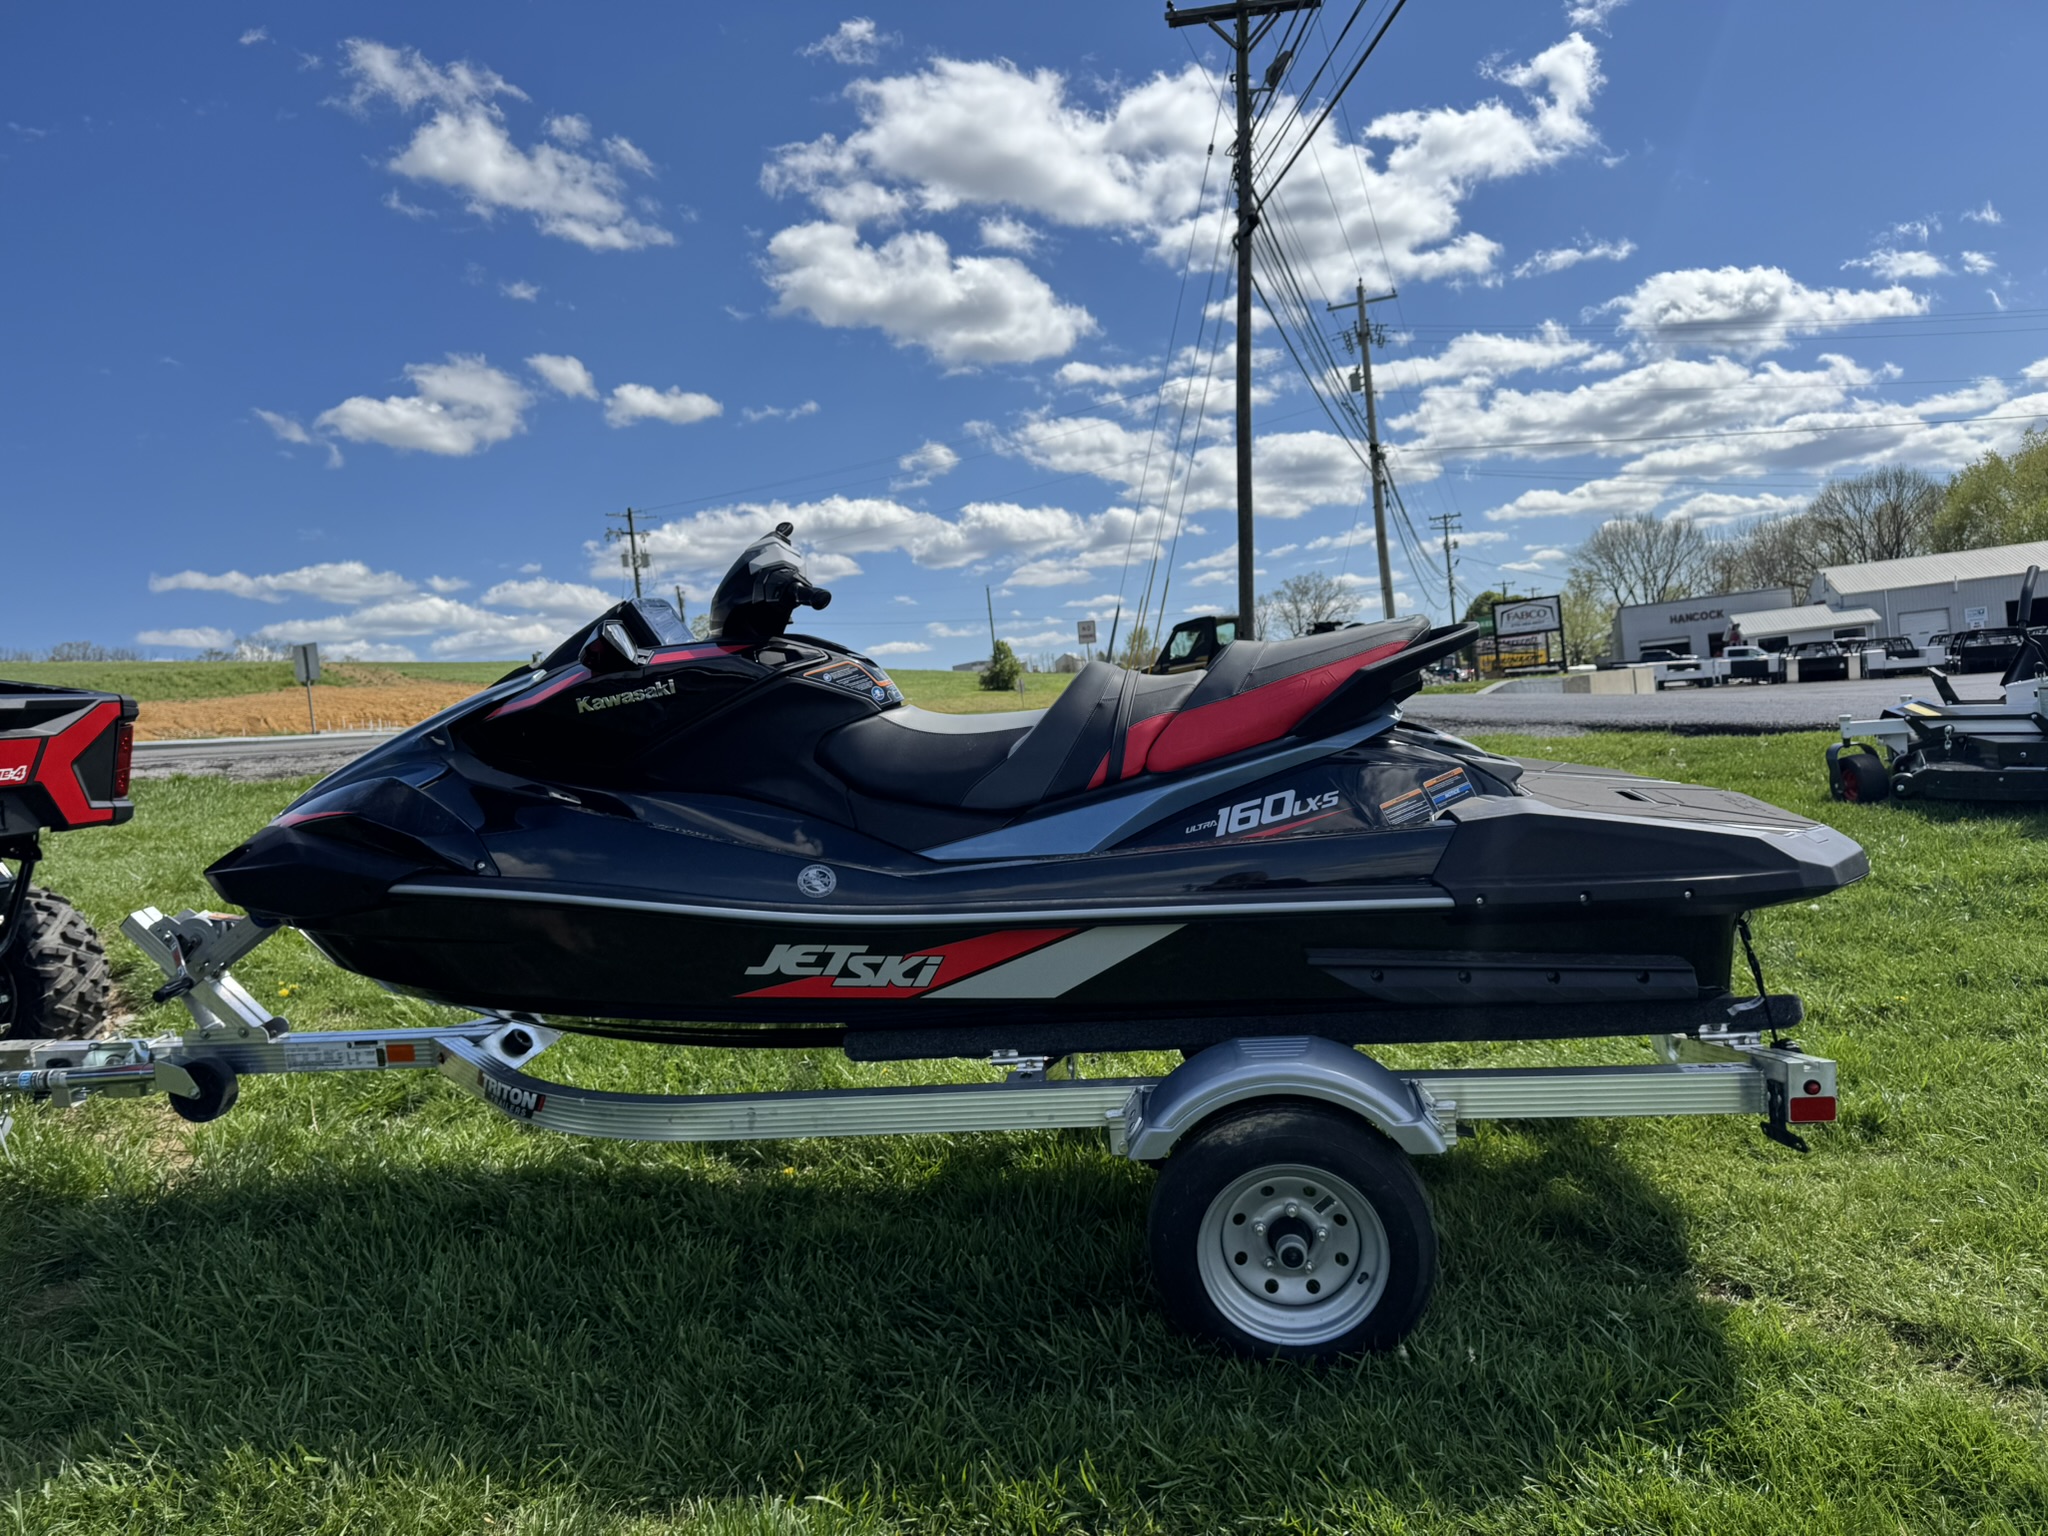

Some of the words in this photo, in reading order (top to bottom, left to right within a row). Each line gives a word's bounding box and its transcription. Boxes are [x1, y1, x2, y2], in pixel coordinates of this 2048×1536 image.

[1507, 608, 1547, 621] FABCO
[1670, 609, 1724, 624] HANCOCK
[576, 679, 676, 713] Kawasaki
[1185, 819, 1218, 834] ULTRA
[1215, 789, 1296, 838] 160
[1293, 790, 1339, 816] LX-S
[482, 1072, 538, 1111] TRITON
[490, 1094, 527, 1117] TRAILERS
